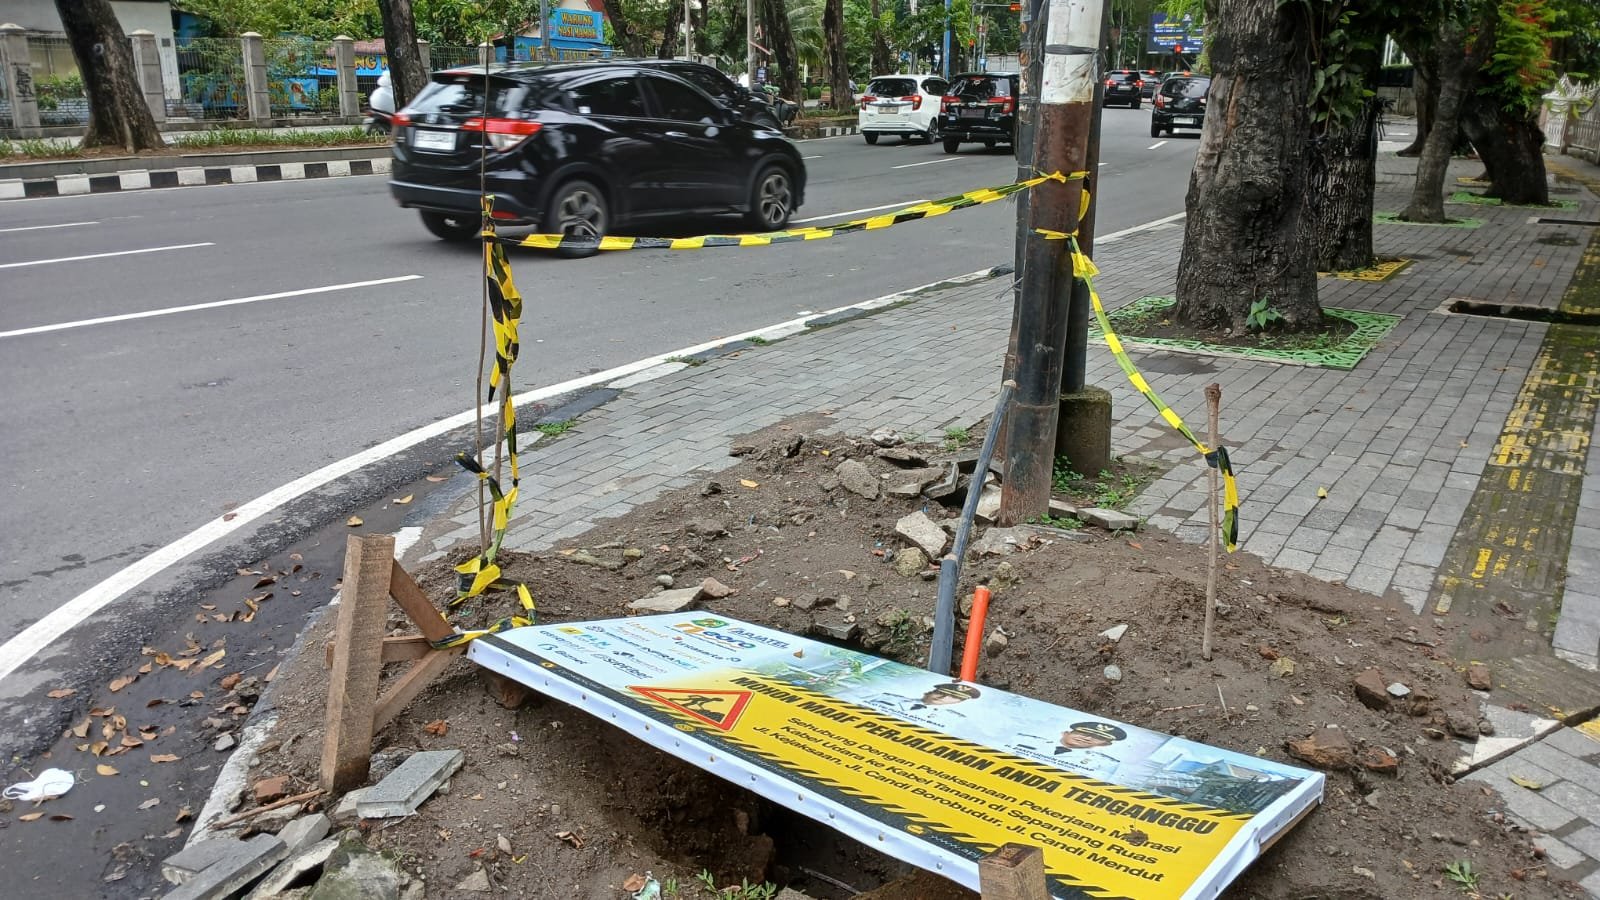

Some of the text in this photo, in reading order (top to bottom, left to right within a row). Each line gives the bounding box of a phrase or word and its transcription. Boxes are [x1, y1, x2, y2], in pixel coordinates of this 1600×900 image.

[562, 13, 593, 26] WARUNG
[729, 677, 803, 704] MOHON
[797, 701, 857, 724] MAAF
[854, 720, 996, 771] PERJALANAN
[990, 766, 1062, 793] ANDA
[1063, 786, 1220, 835] TERGANGGU
[752, 726, 770, 736] Jl.
[769, 732, 842, 766] Kejaksaan,
[845, 763, 862, 773] Jl.
[865, 769, 911, 791] Candi
[910, 787, 1003, 827] Borobudur,
[1006, 825, 1028, 837] Jl.
[1030, 832, 1087, 856] Candi
[1086, 852, 1165, 883] Mendut
[781, 725, 824, 747] Kabel
[822, 741, 866, 761] Udara
[867, 758, 885, 769] ke
[886, 763, 931, 785] Kabel
[932, 782, 985, 806] Tanam
[988, 801, 1009, 813] di
[1007, 809, 1104, 849] Sepanjang
[1106, 844, 1159, 865] Ruas
[788, 717, 1183, 854] Sehubung Dengan Pelaksanaan Pekerjaan Mrasi
